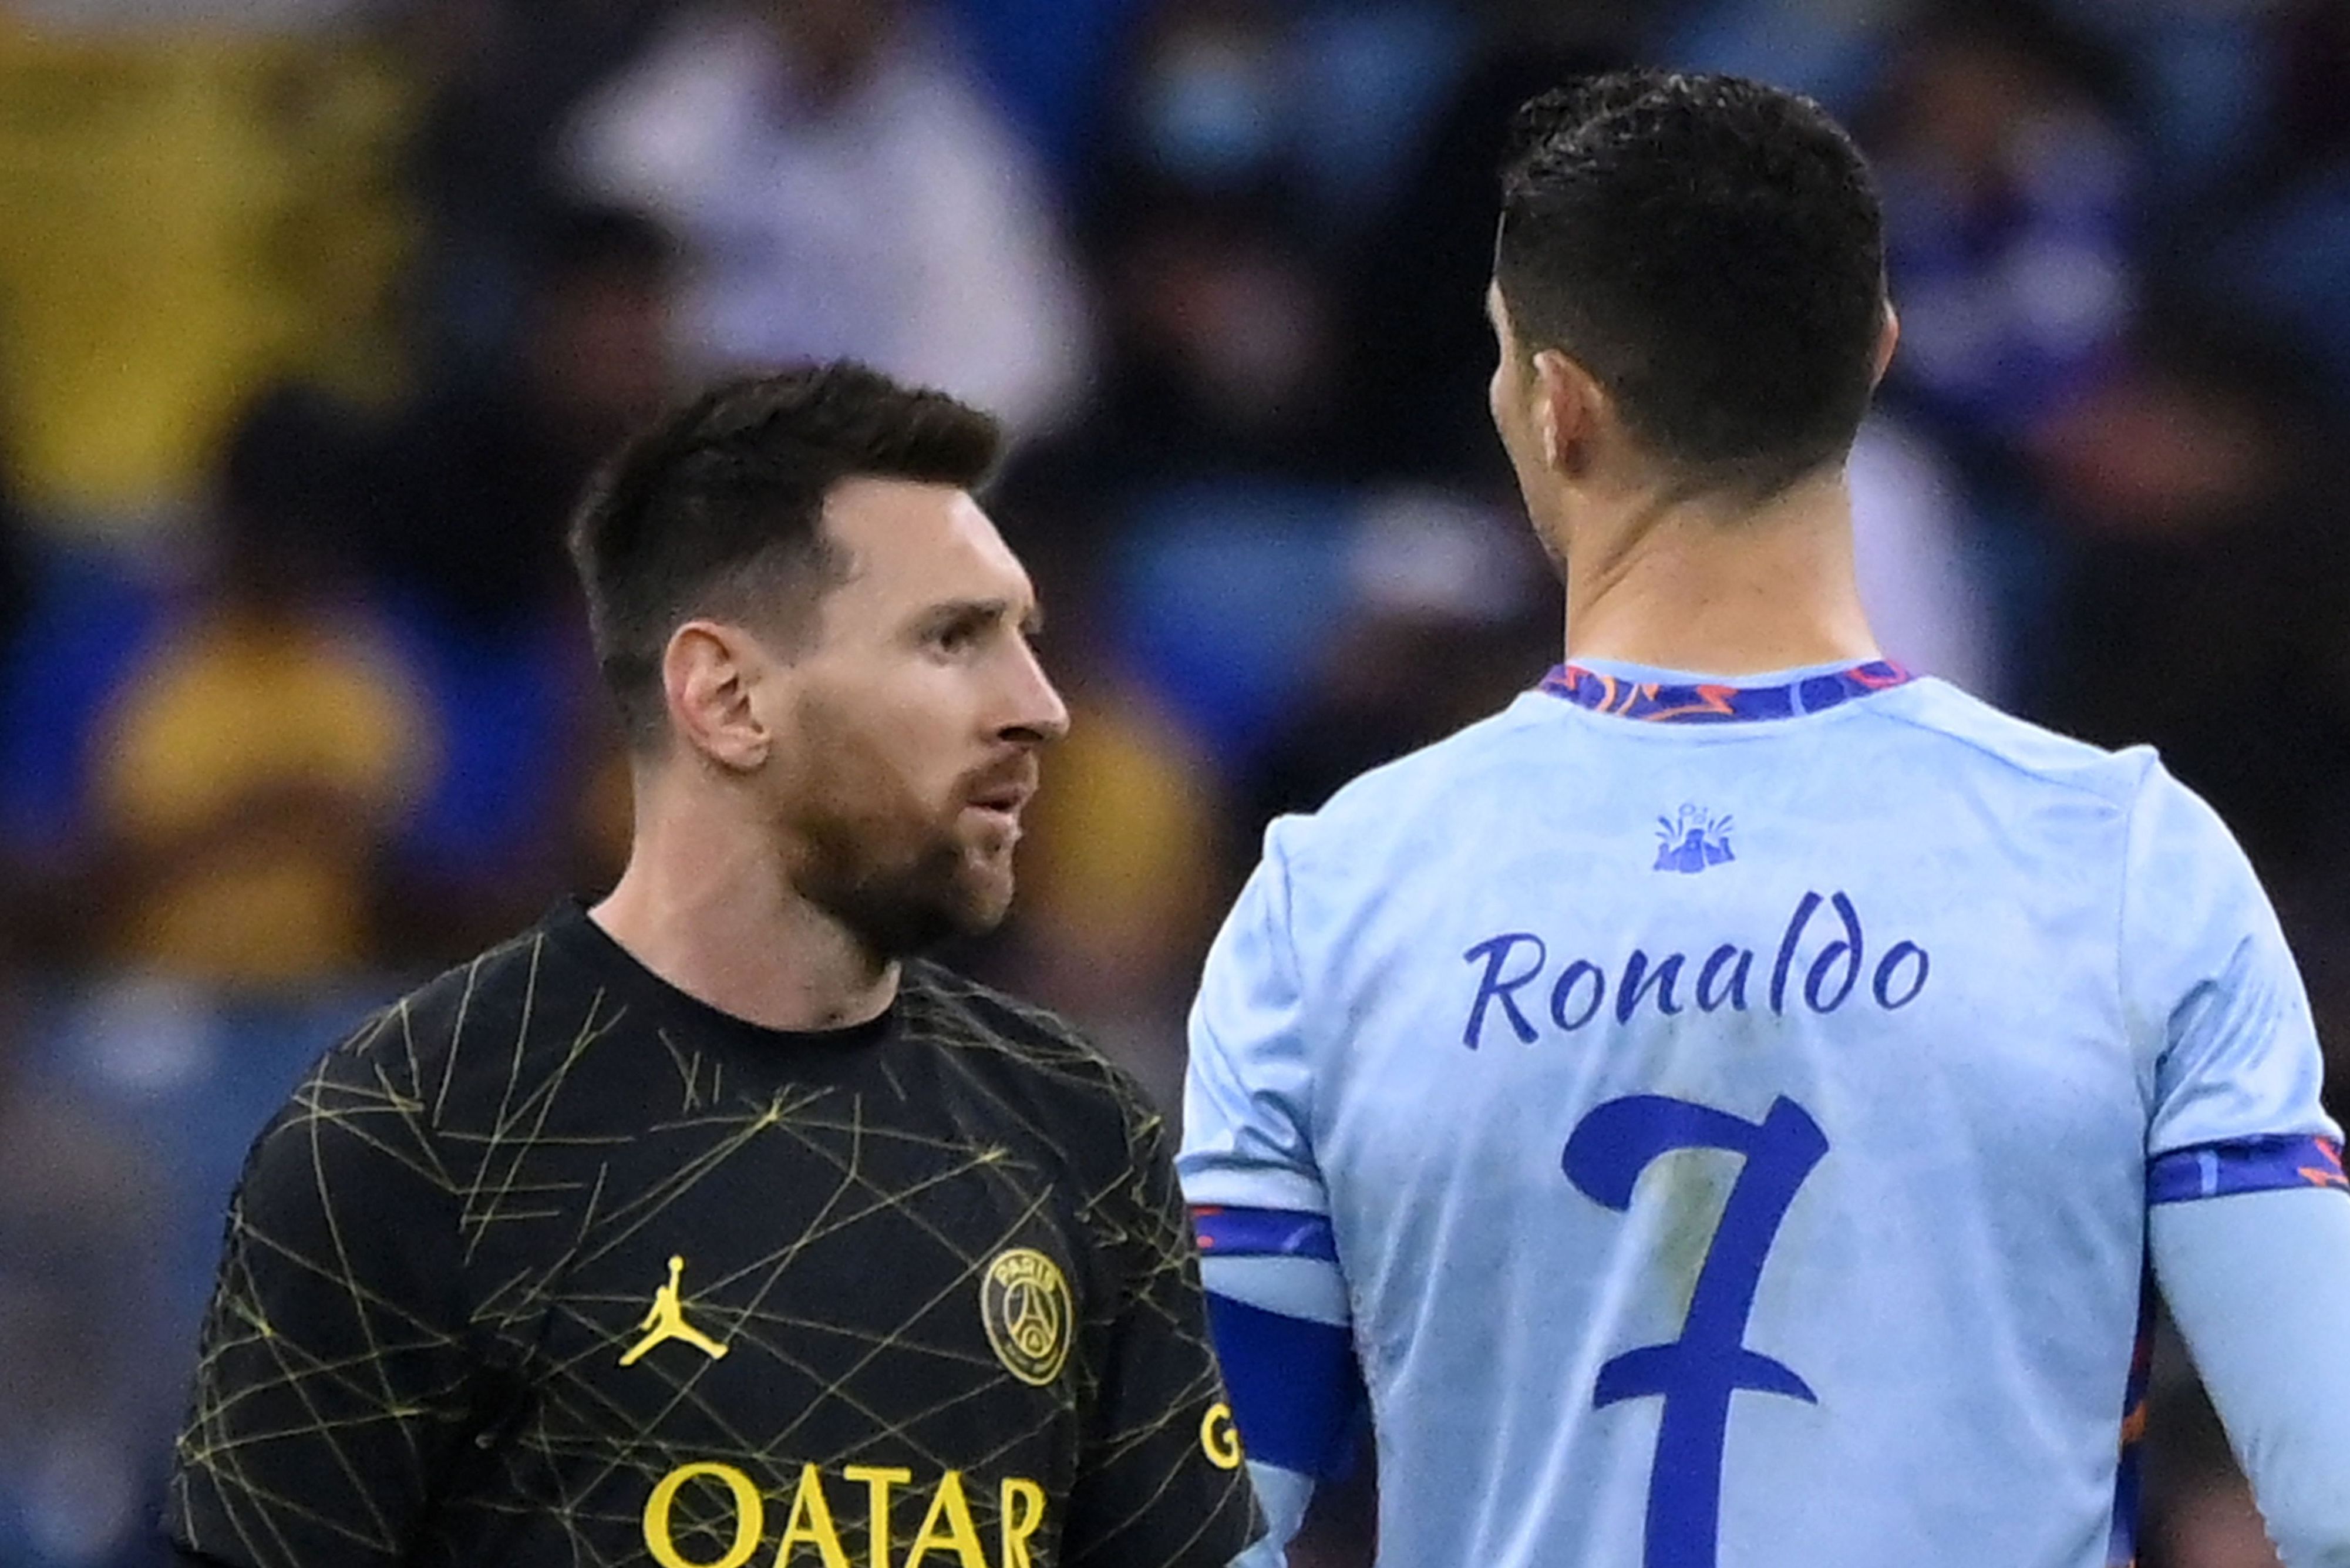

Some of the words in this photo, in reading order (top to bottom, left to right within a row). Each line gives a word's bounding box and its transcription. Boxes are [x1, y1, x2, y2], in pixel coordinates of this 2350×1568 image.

[1463, 891, 1930, 1050] Ronaldo
[1561, 1093, 1830, 1568] 7
[643, 1462, 1046, 1568] QATAR
